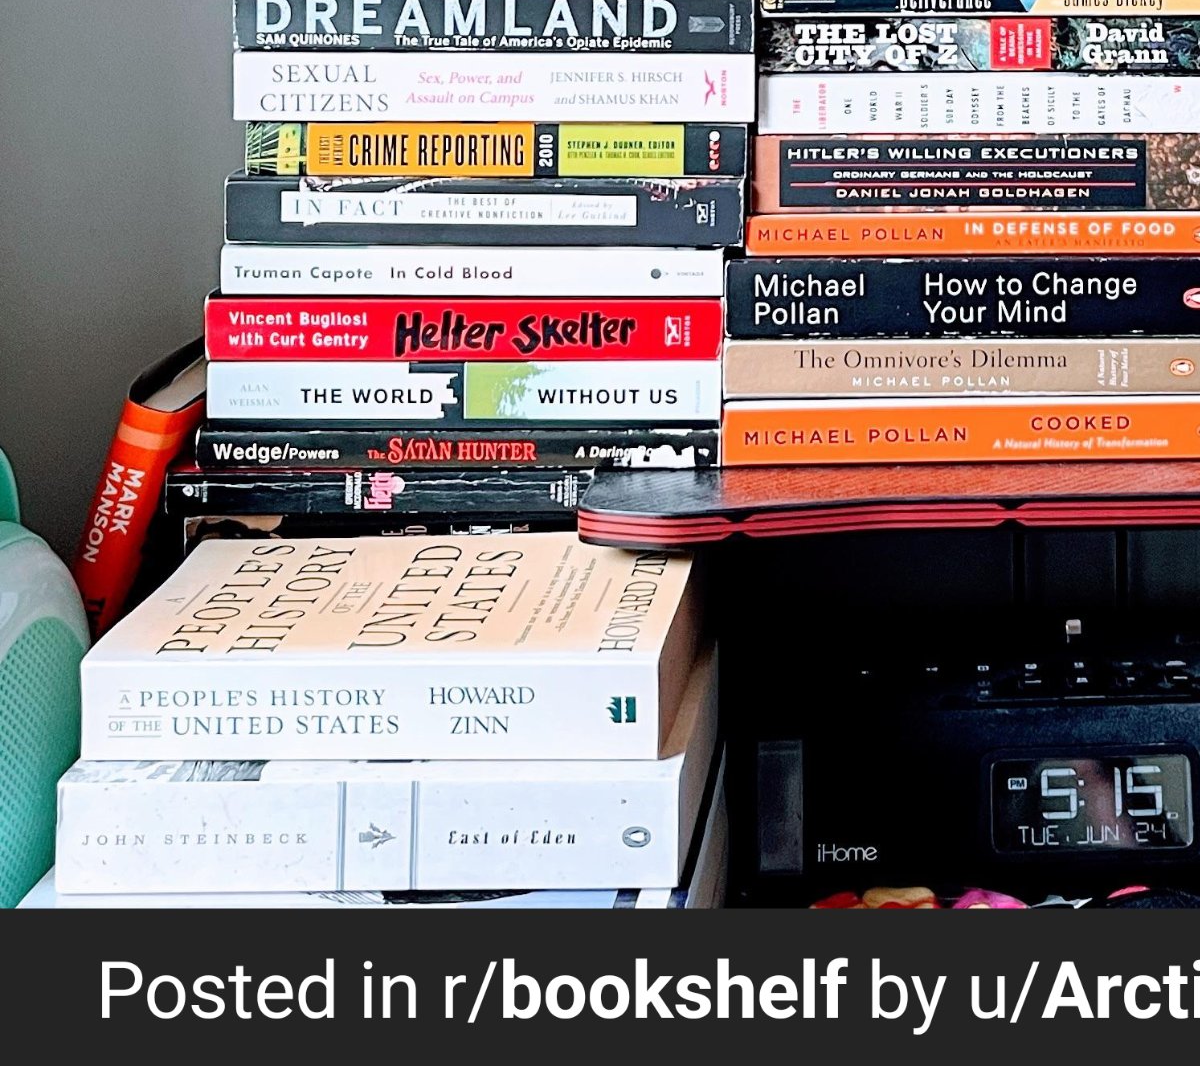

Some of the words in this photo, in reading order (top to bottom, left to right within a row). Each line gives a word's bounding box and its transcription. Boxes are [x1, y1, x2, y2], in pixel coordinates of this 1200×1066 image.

[349, 135, 410, 166] CRIME
[418, 135, 524, 166] REPORTING
[788, 148, 880, 160] HITLER'S
[889, 147, 972, 160] WILLING
[980, 147, 1139, 160] EXECUTIONERS
[924, 274, 989, 297] How
[996, 276, 1022, 296] to
[1033, 275, 1137, 300] Change
[924, 303, 988, 324] Your
[998, 300, 1067, 324] Mind
[795, 350, 835, 370] The
[844, 349, 963, 369] Omnivore's
[972, 349, 1068, 369] Dilemma
[300, 389, 343, 404] THE
[352, 389, 433, 404] WORLD
[538, 389, 640, 404] WITHOUT
[650, 389, 678, 404] US
[271, 689, 386, 707] HISTORY
[429, 686, 535, 706] HOWARD
[172, 715, 283, 736] UNITED
[296, 714, 399, 734] STATES
[450, 715, 510, 734] ZINN
[1009, 779, 1026, 789] PM
[1136, 823, 1166, 843] 24
[817, 844, 878, 863] iHome
